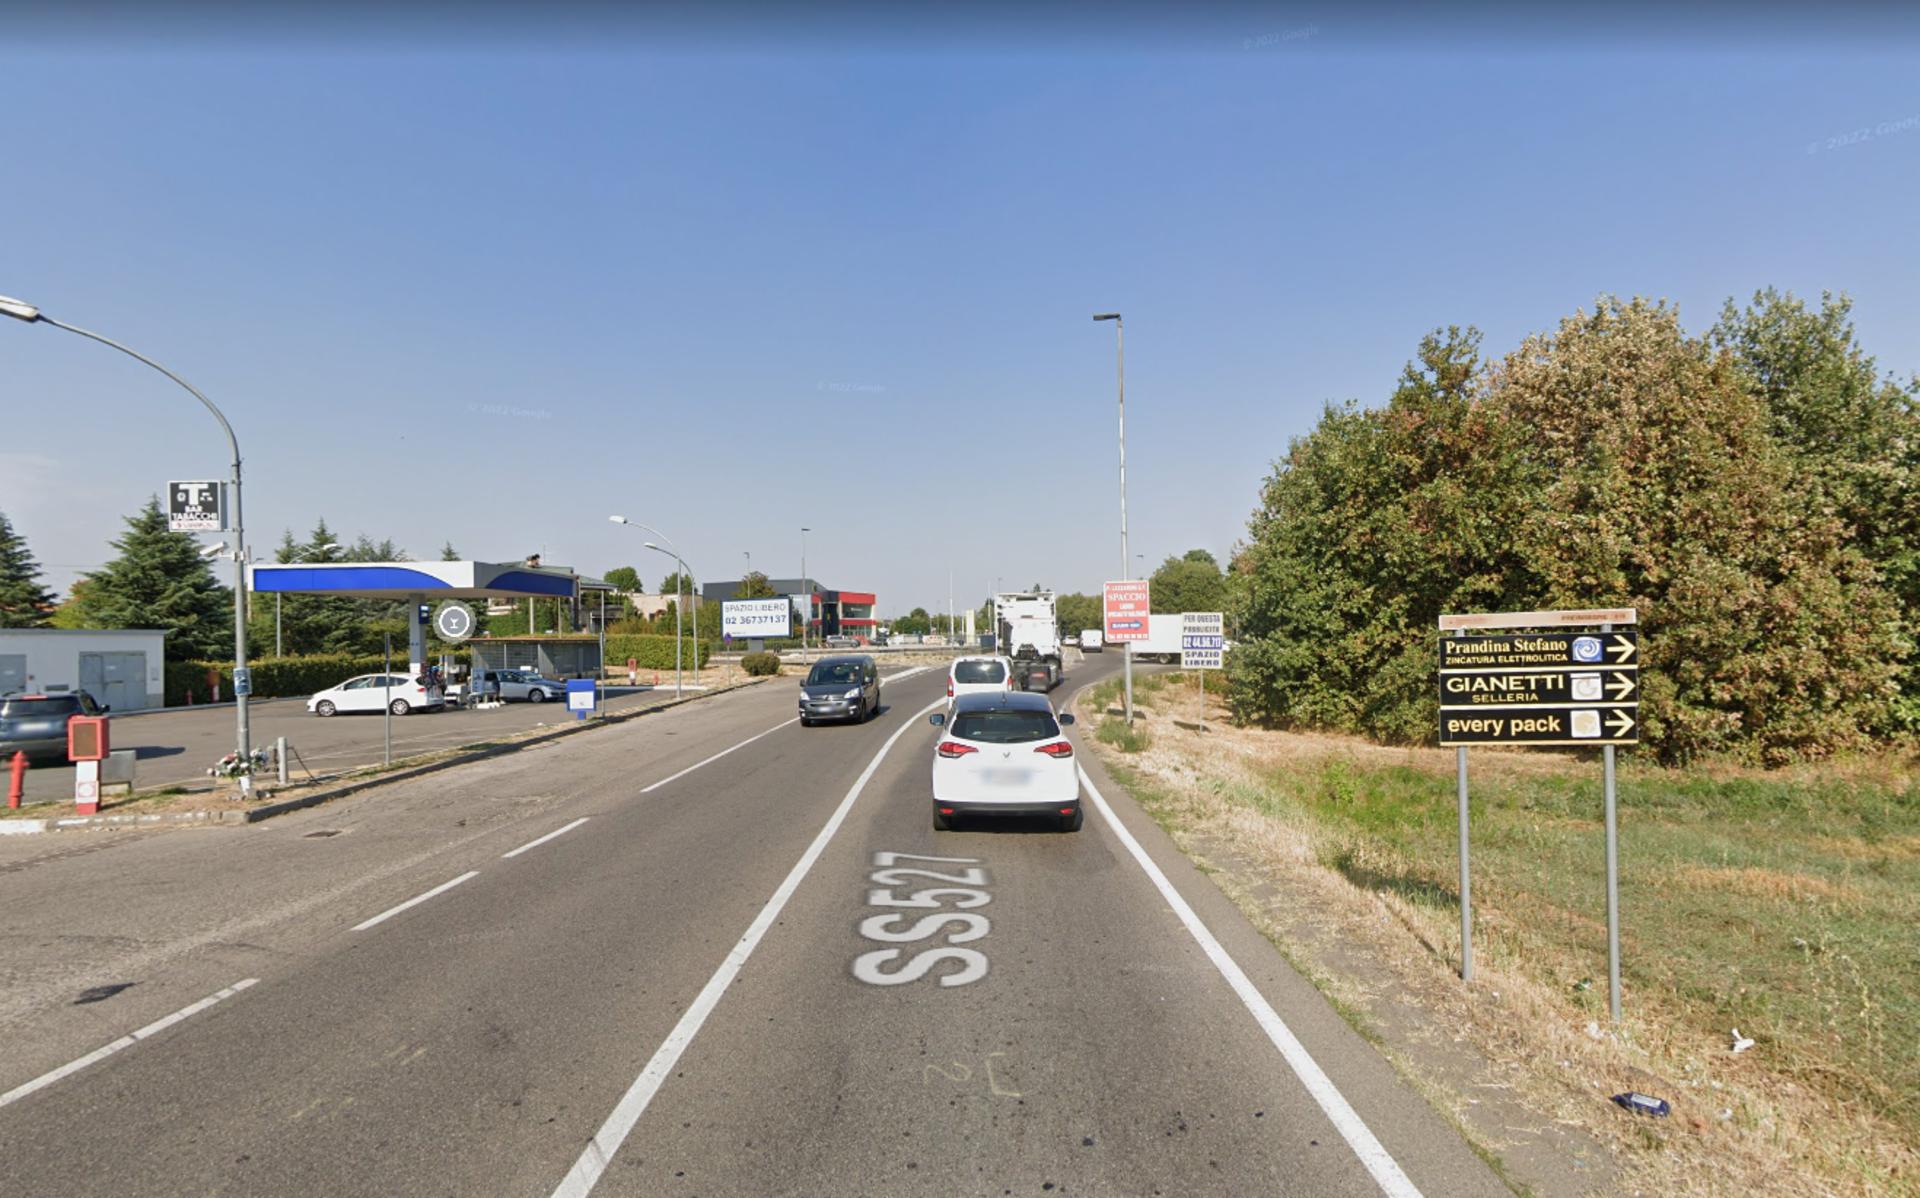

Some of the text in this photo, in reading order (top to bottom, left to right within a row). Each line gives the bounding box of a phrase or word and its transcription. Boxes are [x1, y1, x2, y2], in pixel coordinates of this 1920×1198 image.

[179, 484, 209, 505] T
[171, 512, 218, 521] TABACCHI
[1107, 592, 1146, 601] SPACCIO
[725, 602, 786, 612] SPAZIO LIBERO
[725, 614, 787, 625] 02 36737137
[1184, 614, 1220, 623] PER QUESTA
[1445, 637, 1568, 655] Prandina Stefano
[1184, 659, 1220, 667] LIBERO
[1445, 653, 1569, 665] ZINCATURA ELETTROLITICA
[1446, 674, 1565, 693] GIANETTI
[1471, 692, 1540, 704] SELLERIA
[1447, 715, 1562, 737] every pack
[853, 852, 992, 987] SS527
